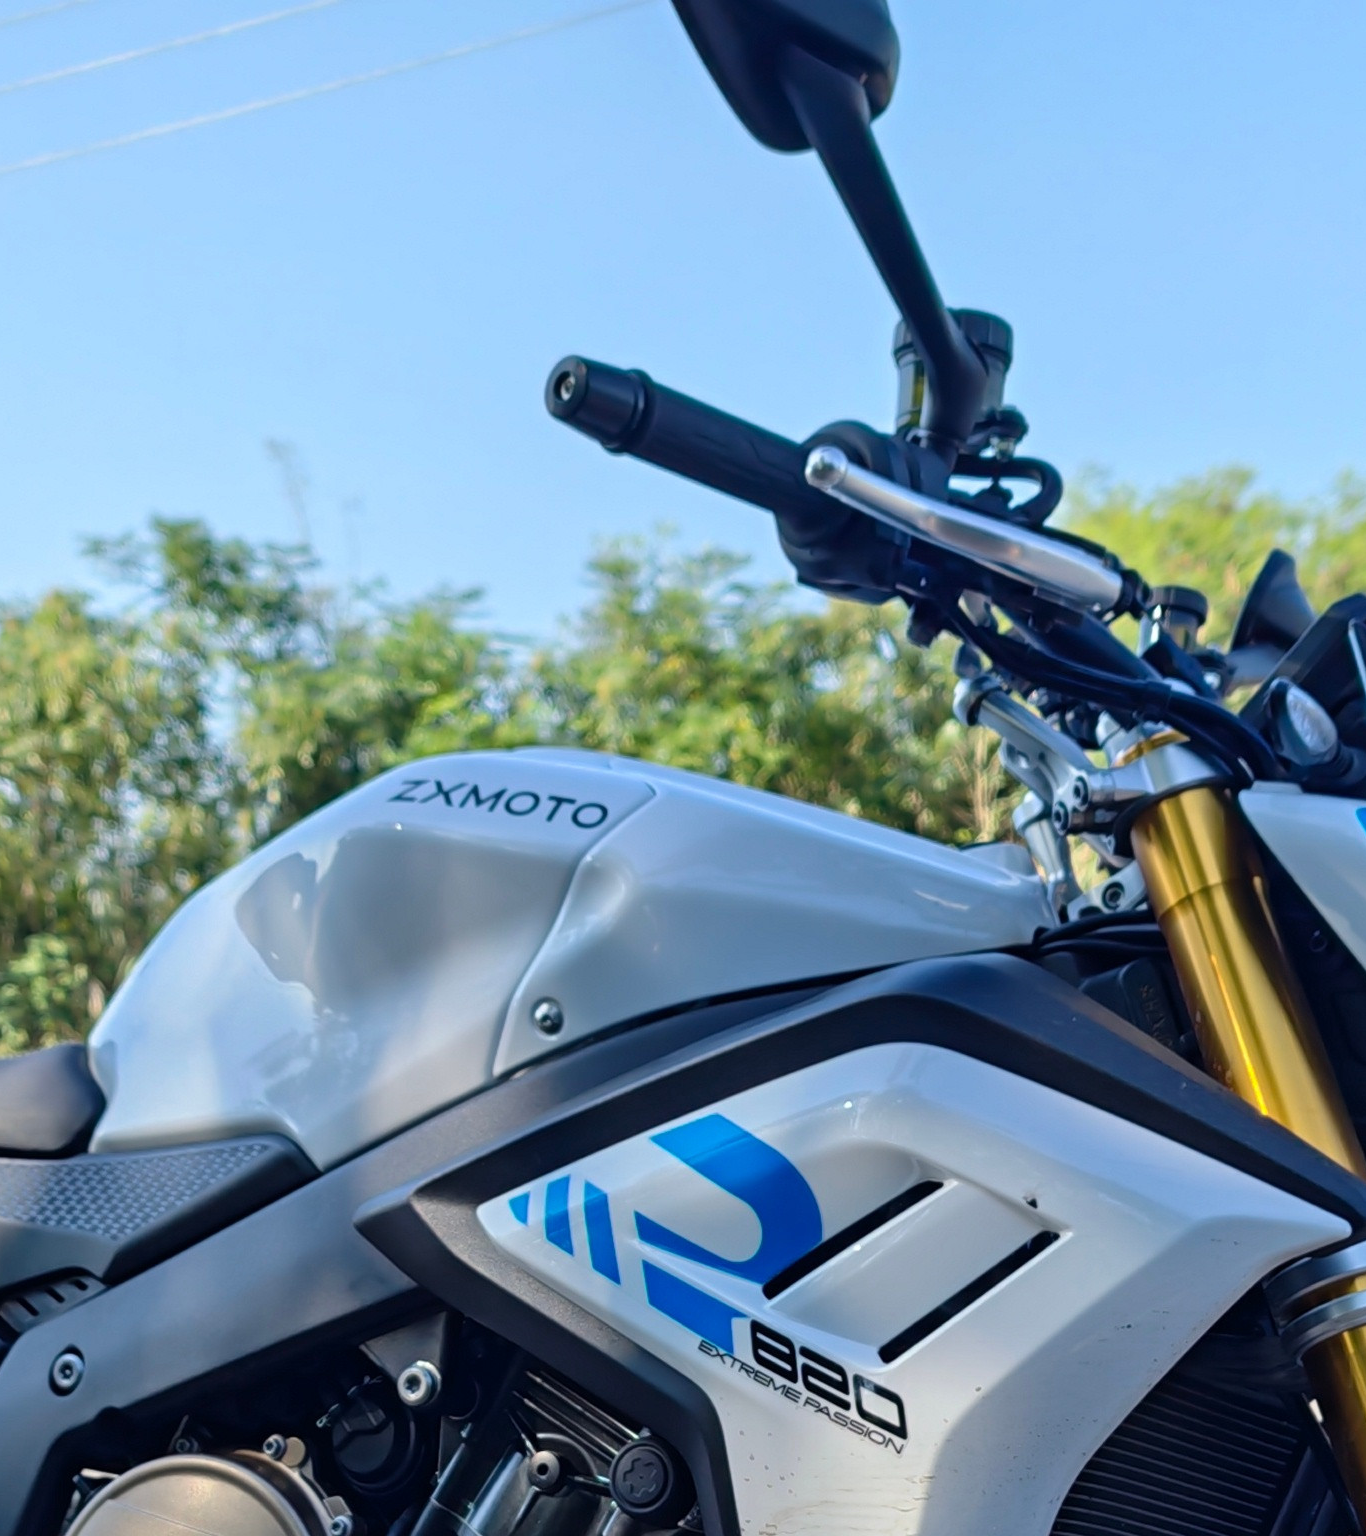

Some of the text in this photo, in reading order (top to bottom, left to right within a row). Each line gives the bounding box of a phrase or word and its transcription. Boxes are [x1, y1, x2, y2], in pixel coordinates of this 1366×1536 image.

[387, 779, 609, 829] ZXMOTO
[697, 1339, 905, 1455] EXTREME PASSION
[750, 1319, 908, 1440] 820
